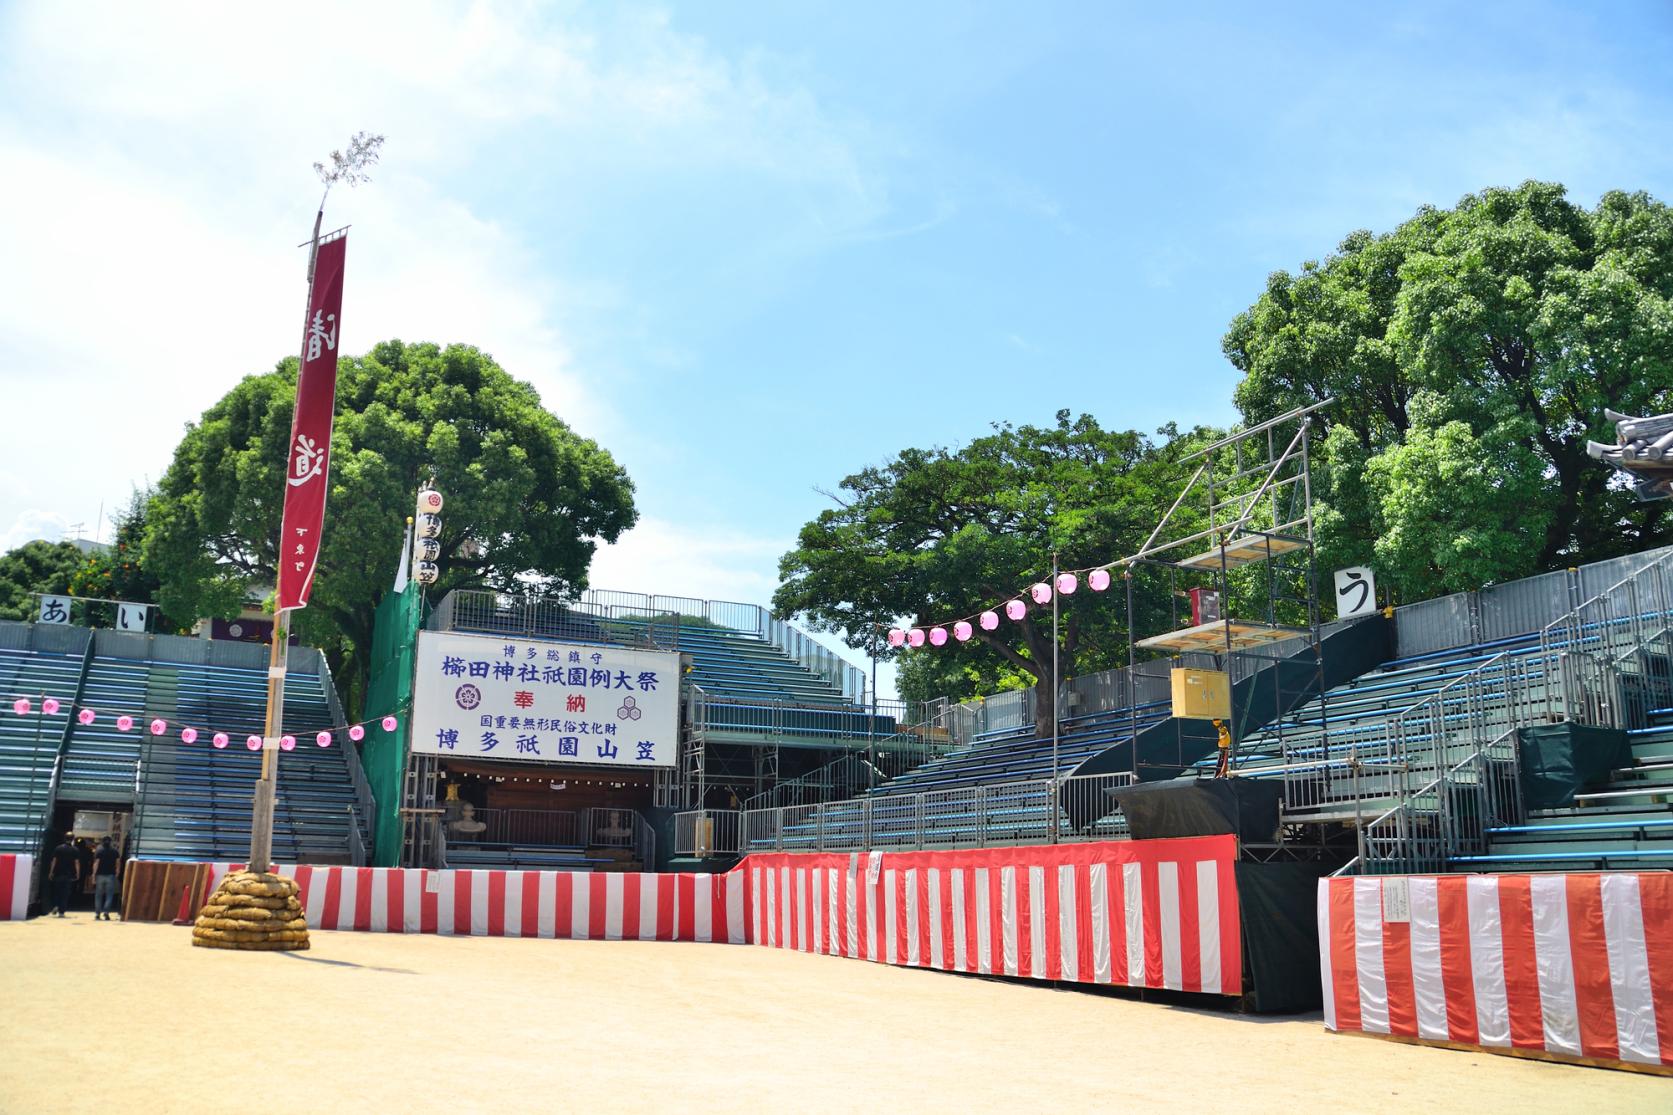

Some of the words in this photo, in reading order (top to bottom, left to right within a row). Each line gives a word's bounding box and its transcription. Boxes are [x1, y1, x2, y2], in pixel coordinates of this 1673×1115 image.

[1339, 572, 1369, 613] う
[42, 599, 67, 623] あ
[120, 607, 144, 629] い
[503, 644, 603, 665] 博多総鎮守
[441, 655, 660, 692] 櫛田神社祇園例大祭
[513, 690, 587, 713] 奉納
[480, 714, 617, 736] 国重要無形民俗文化財
[436, 728, 656, 761] 博多祇園山笠
